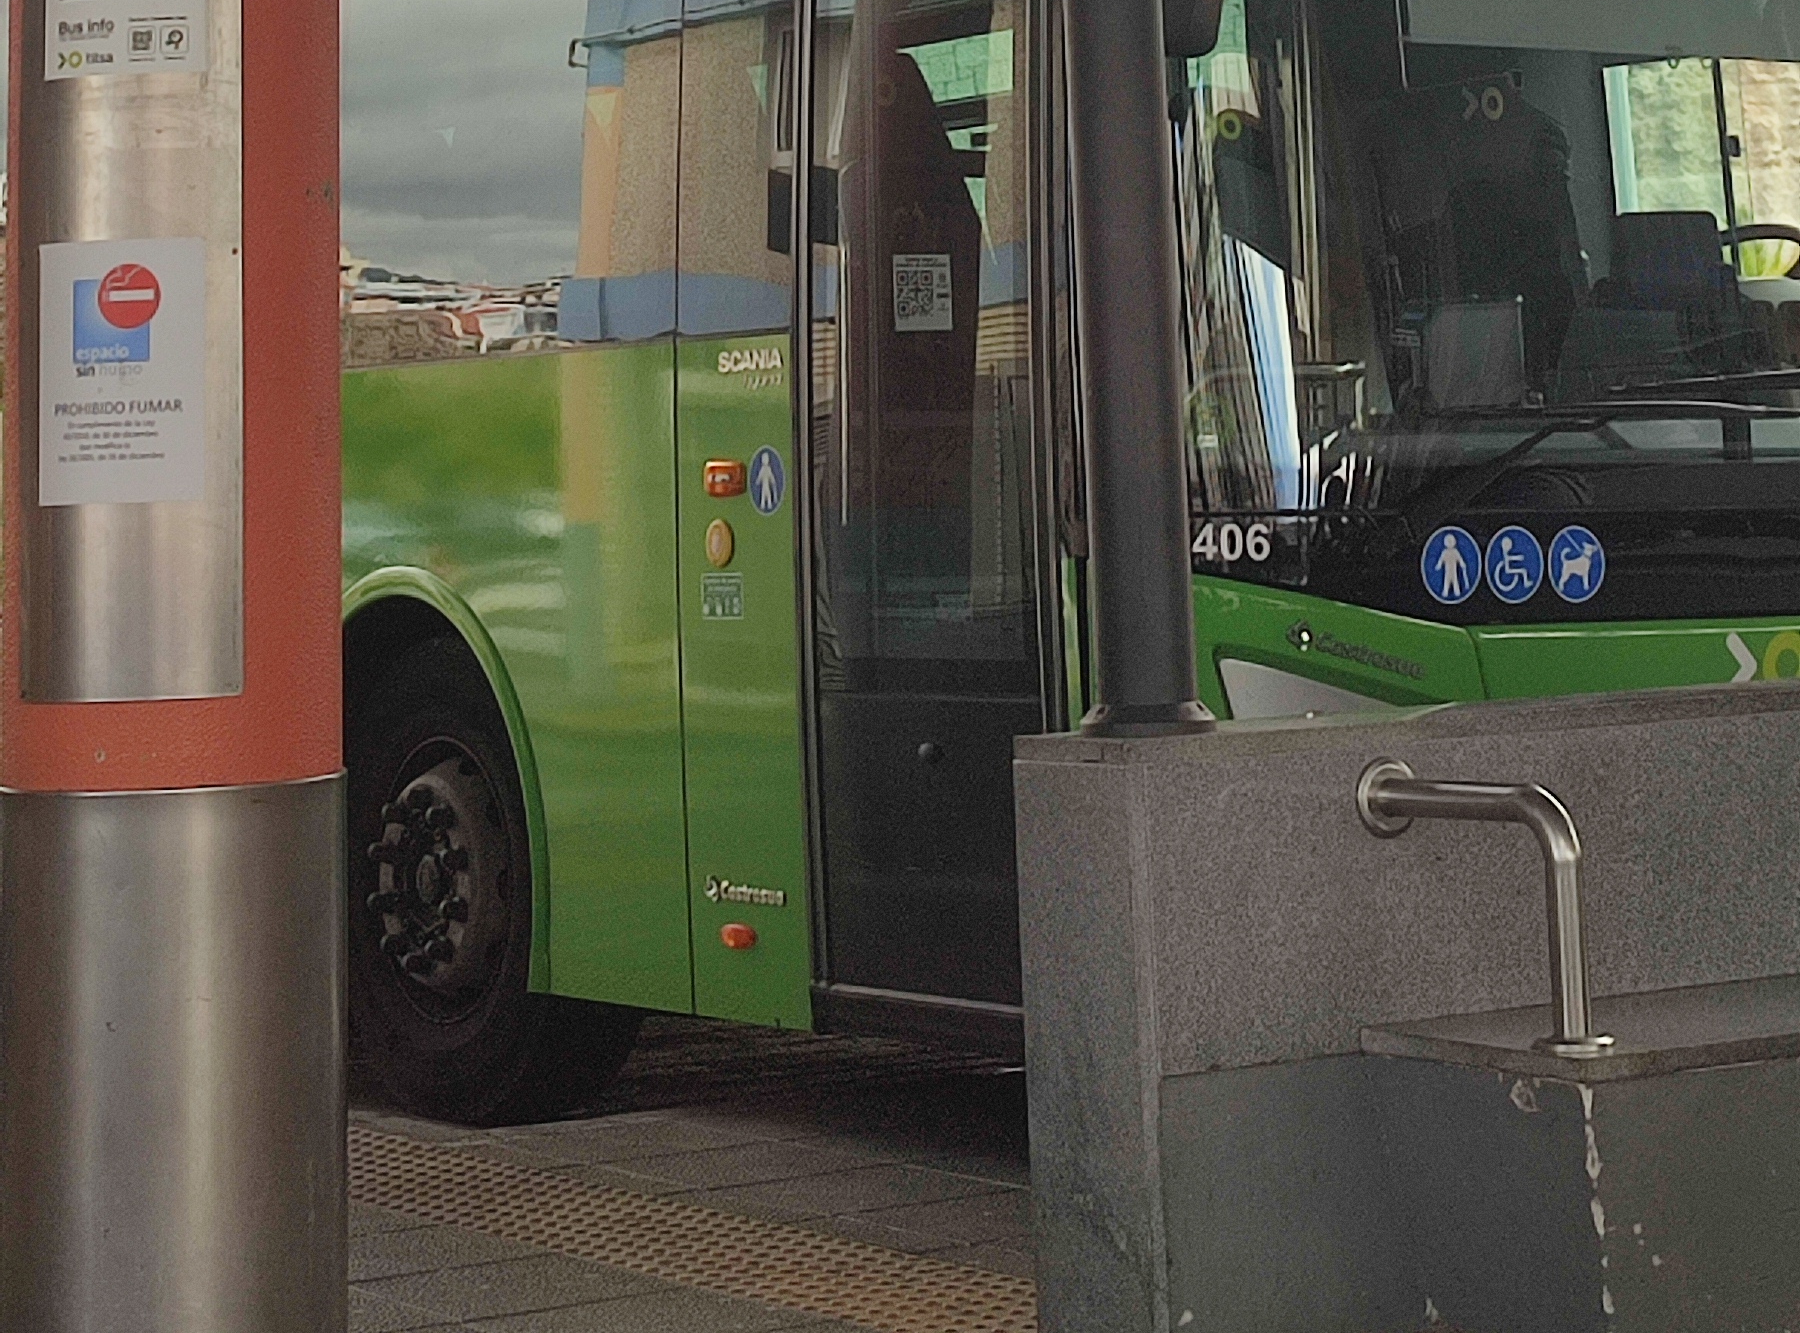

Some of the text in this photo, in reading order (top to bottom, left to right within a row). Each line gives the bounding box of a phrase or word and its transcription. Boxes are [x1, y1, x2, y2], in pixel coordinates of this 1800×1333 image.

[58, 20, 83, 36] Bus
[87, 18, 115, 33] info
[75, 343, 130, 363] espacio
[717, 347, 783, 373] SCANIA
[54, 398, 184, 417] PROHIBIDO FUMAR
[1191, 522, 1271, 562] 406
